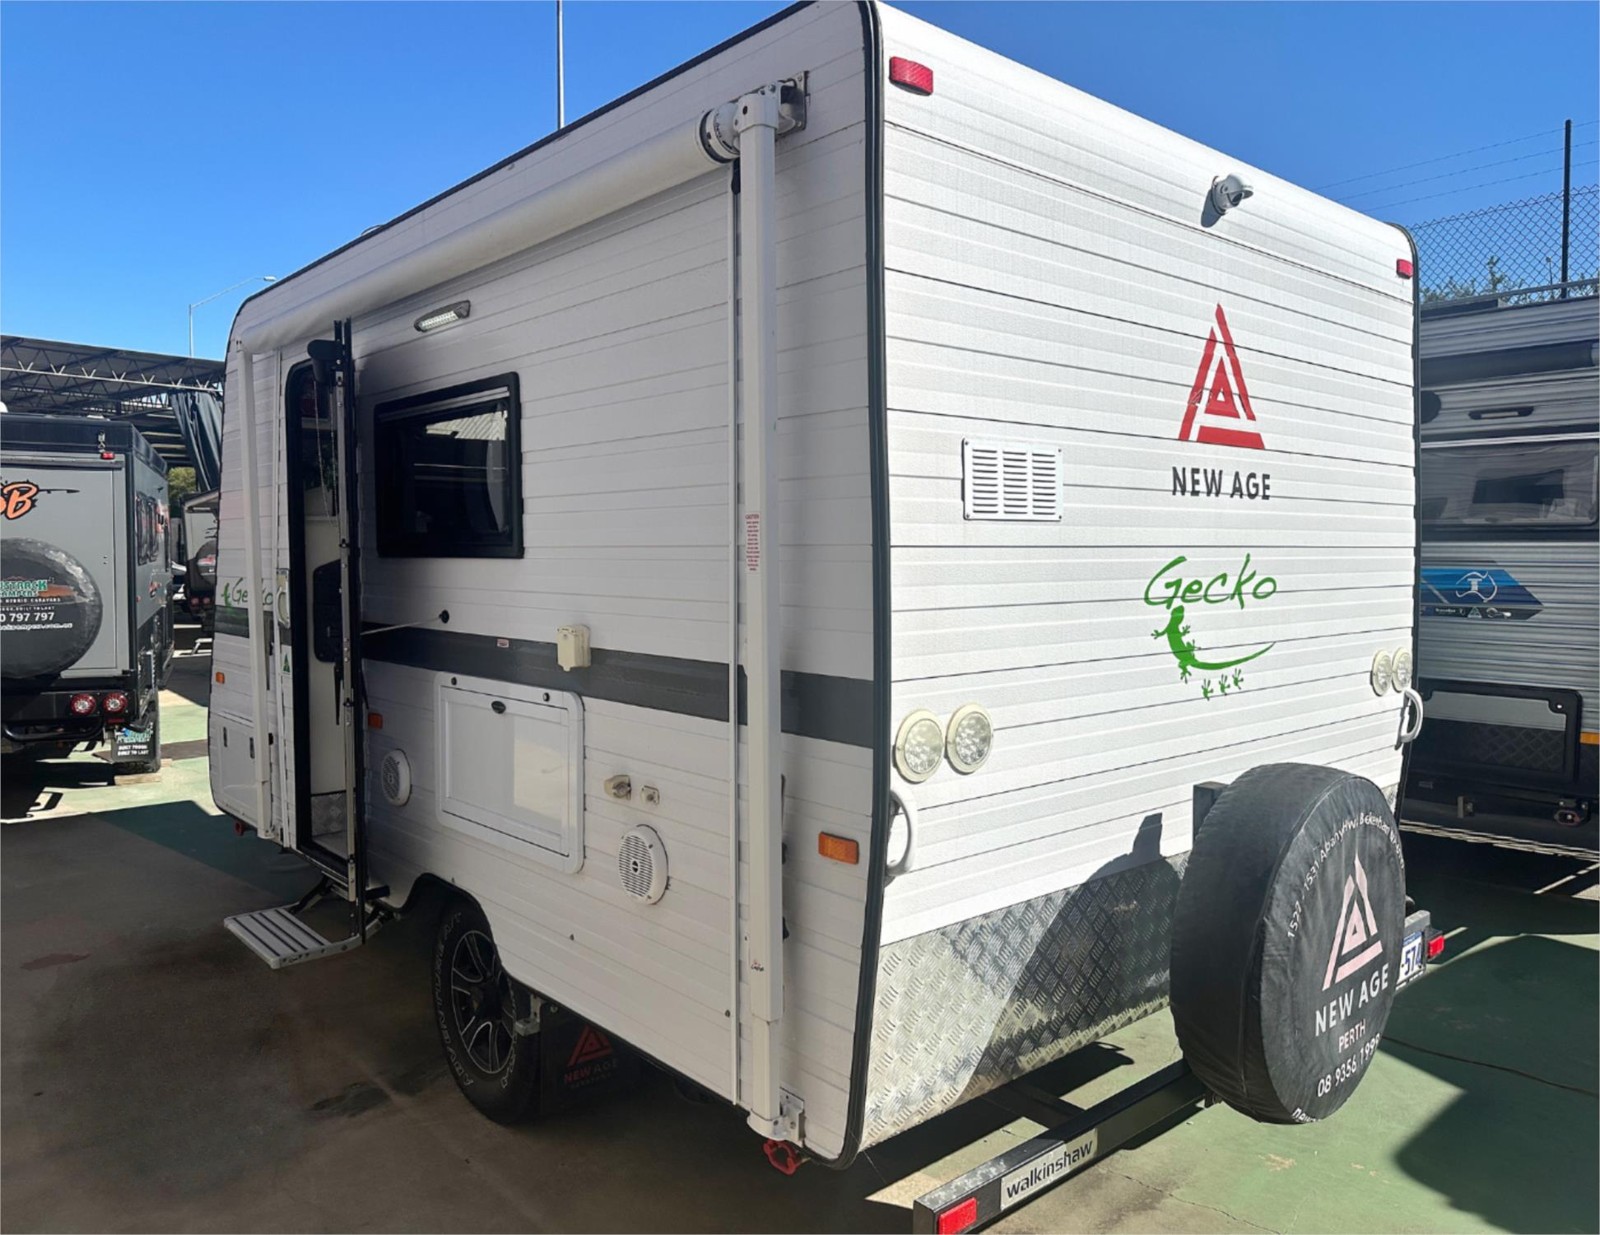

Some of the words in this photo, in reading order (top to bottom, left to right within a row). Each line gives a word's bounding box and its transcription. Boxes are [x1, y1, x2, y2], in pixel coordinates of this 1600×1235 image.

[1172, 466, 1223, 497] NEW
[1230, 471, 1271, 500] AGE
[231, 578, 273, 605] Geo
[1144, 553, 1277, 609] Gecko
[9, 612, 30, 621] 797
[34, 611, 55, 621] 797
[1315, 989, 1354, 1037] NEW
[1358, 963, 1389, 1009] AGE
[1338, 1018, 1366, 1053] PERTH
[1317, 1074, 1331, 1097] 08
[1335, 1054, 1357, 1087] 9356
[1006, 1140, 1093, 1199] walkinshaw
